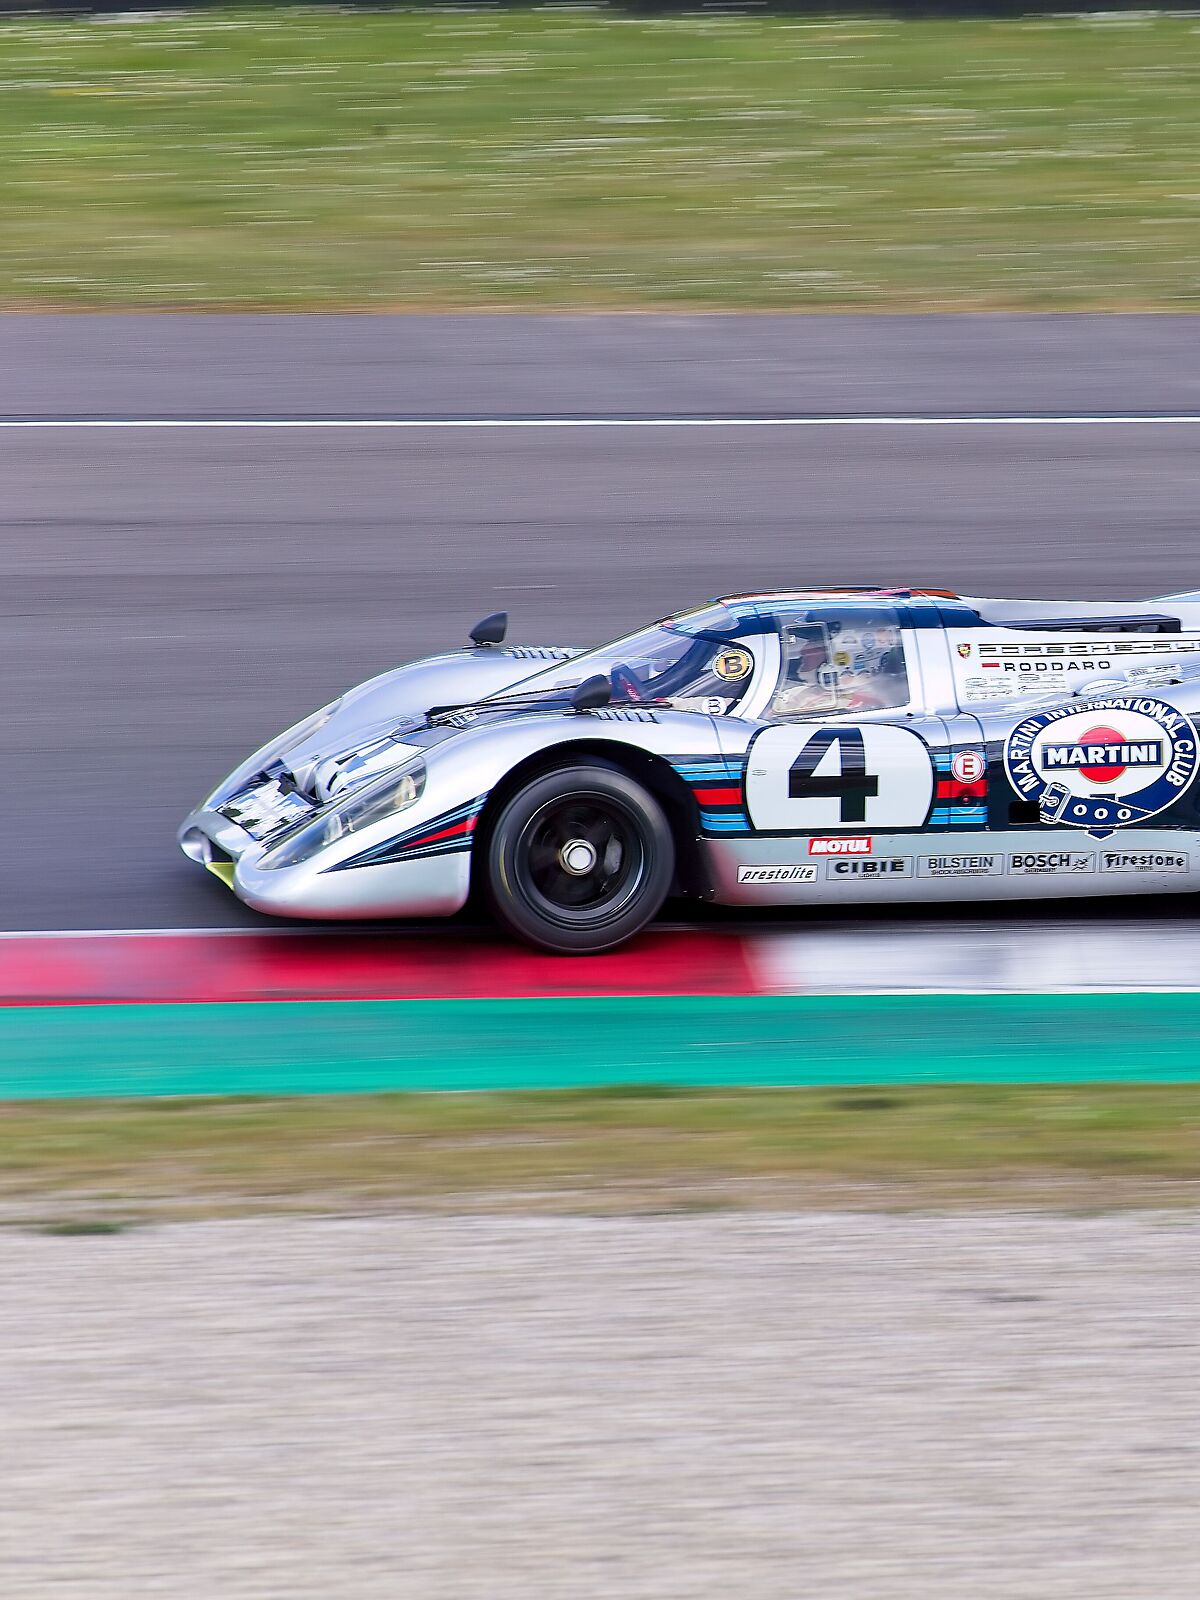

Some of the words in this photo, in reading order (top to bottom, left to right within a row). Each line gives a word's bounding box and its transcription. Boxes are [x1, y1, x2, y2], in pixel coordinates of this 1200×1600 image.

[722, 655, 743, 675] B
[1004, 661, 1110, 671] RODDARO
[1010, 718, 1043, 793] MARTINI
[1044, 699, 1185, 738] INTERNATIONAL
[1166, 739, 1194, 787] CLUB
[1047, 744, 1158, 766] MARTINI
[962, 758, 975, 775] E
[788, 728, 879, 822] 4
[811, 839, 870, 854] MOTUL
[928, 857, 994, 869] BILSTEIN
[1012, 854, 1070, 868] BOSCH
[1104, 853, 1185, 869] Firestone
[741, 866, 814, 882] prestolite
